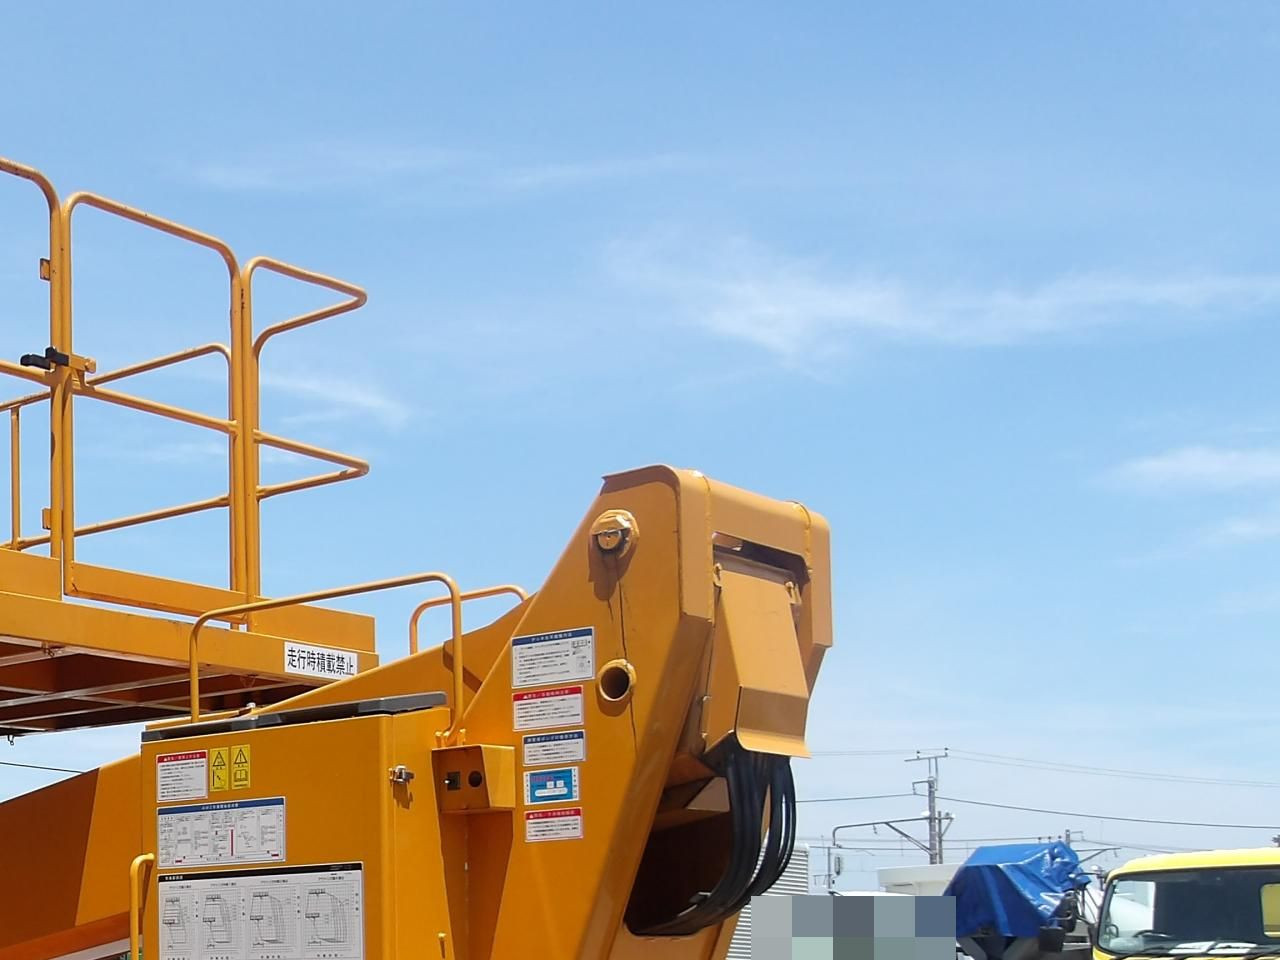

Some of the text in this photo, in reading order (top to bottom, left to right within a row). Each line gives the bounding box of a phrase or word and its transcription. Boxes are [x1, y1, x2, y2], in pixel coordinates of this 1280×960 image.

[287, 646, 355, 676] 走行時積載禁止
